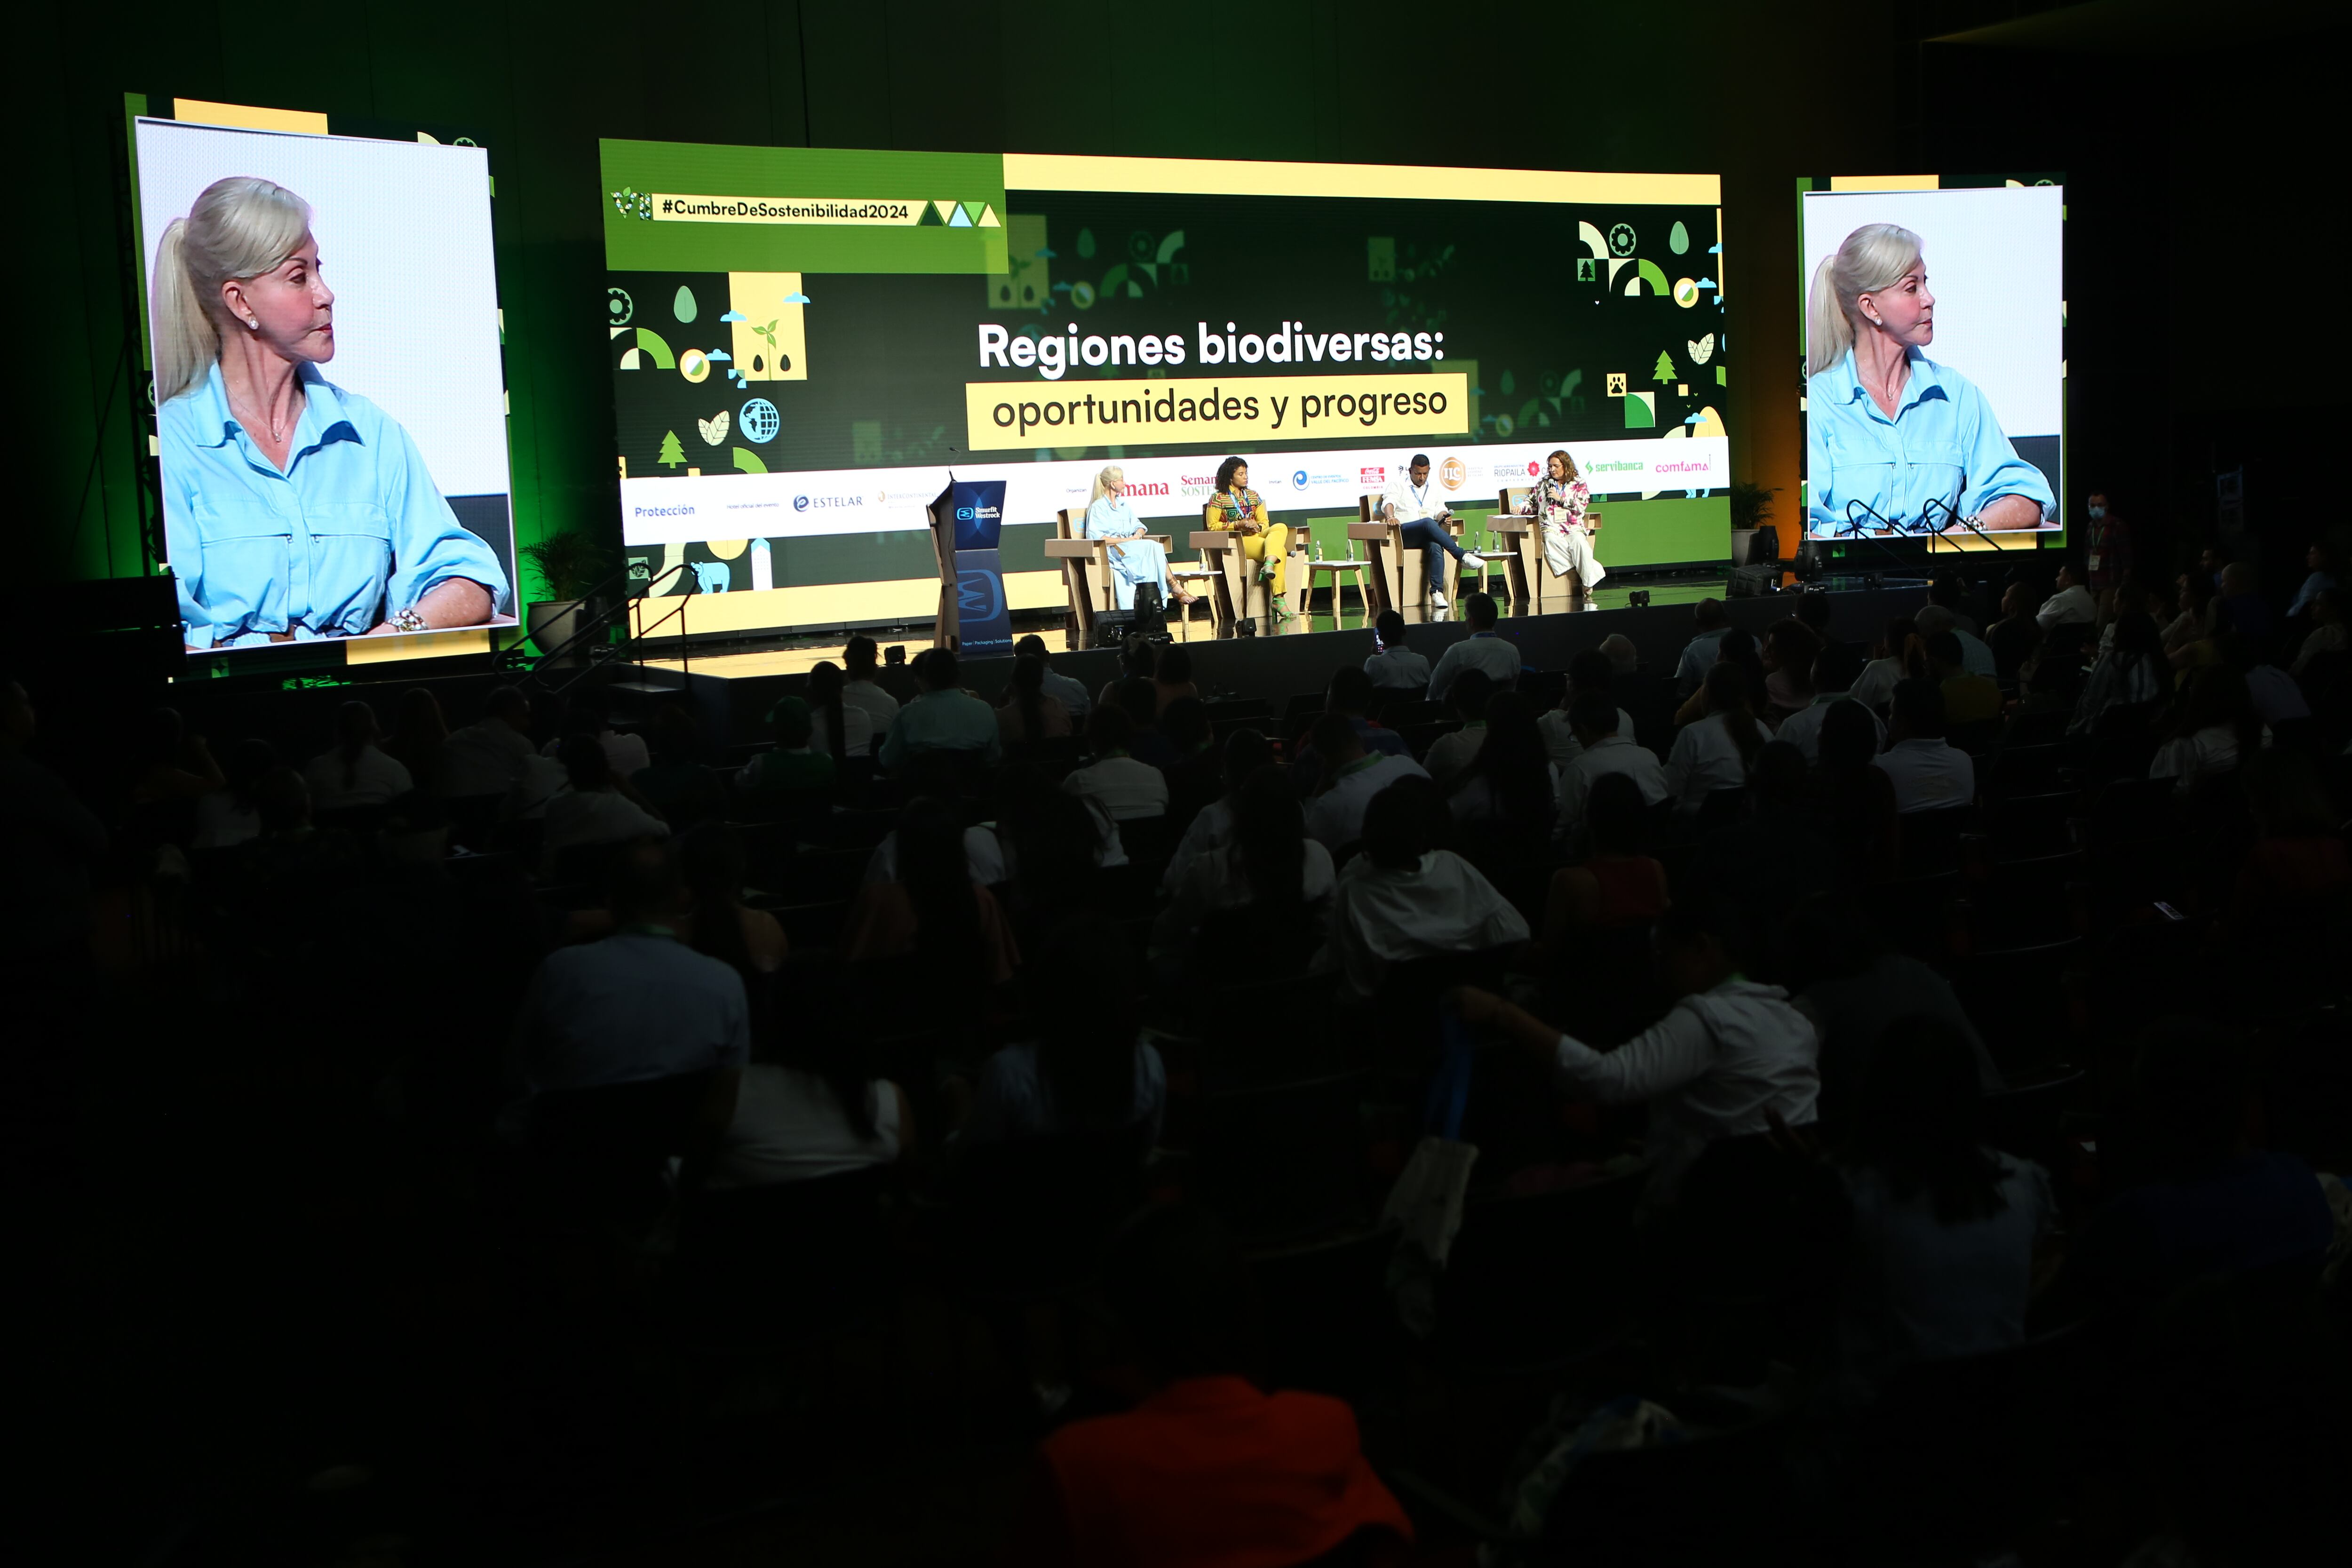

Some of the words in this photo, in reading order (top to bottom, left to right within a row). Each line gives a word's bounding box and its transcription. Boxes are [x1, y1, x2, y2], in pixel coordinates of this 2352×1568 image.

[662, 199, 909, 219] #CumbreDeSostenibilidad2024
[978, 323, 1185, 380] Regiones
[1198, 321, 1444, 364] biodiversas:
[993, 388, 1259, 437] oportunidades
[1271, 391, 1289, 429] y
[1302, 390, 1447, 428] progreso
[1596, 461, 1643, 471] servibanca
[1655, 461, 1708, 472] comfama
[1494, 469, 1526, 477] RIOPAILA
[1181, 475, 1218, 485] Seman
[1120, 482, 1169, 496] mana
[1181, 485, 1215, 496] SOSTE
[813, 496, 863, 508] ESTELAR
[635, 504, 695, 517] Protección
